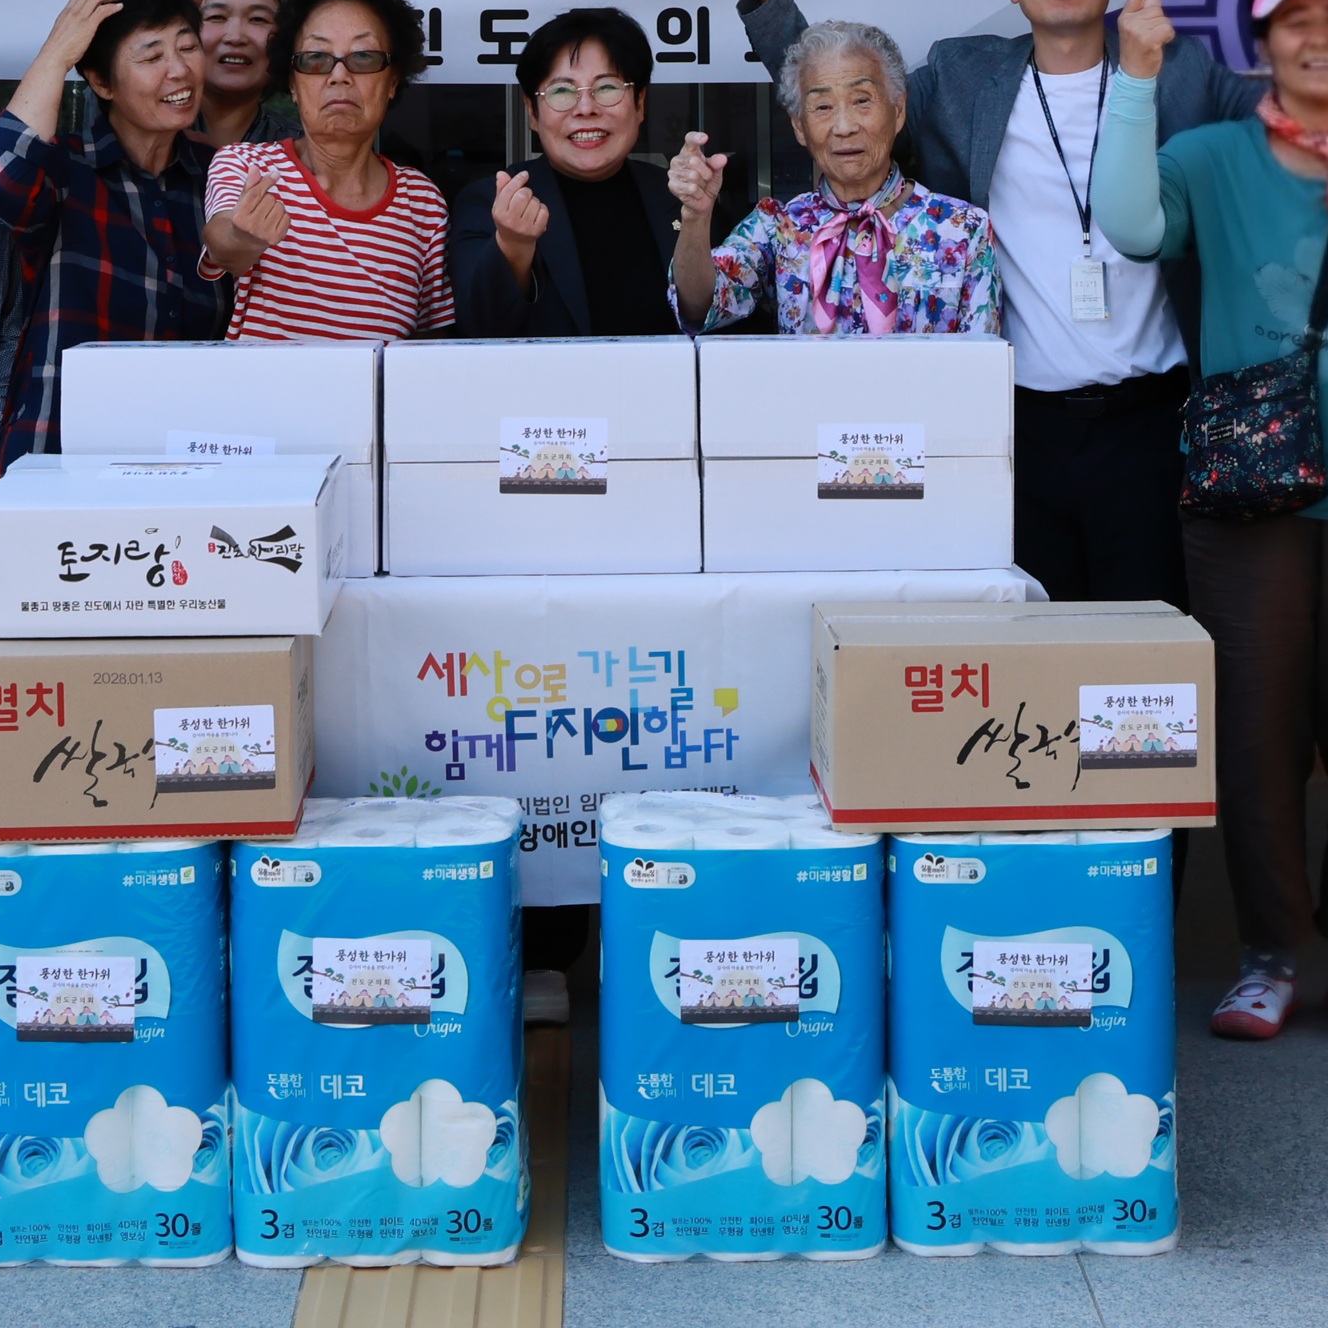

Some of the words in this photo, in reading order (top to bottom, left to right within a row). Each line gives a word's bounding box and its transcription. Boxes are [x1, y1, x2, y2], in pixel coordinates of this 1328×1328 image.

[522, 427, 553, 439] 풍성한
[556, 427, 586, 439] 한가위
[839, 433, 870, 444] 풍성한
[873, 433, 903, 445] 한가위
[187, 441, 219, 454] 풍성한
[222, 445, 253, 455] 한가위
[57, 539, 171, 588] 토지랑
[21, 601, 49, 613] 물좋고
[52, 600, 81, 612] 땅좋은
[84, 600, 122, 612] 진도에서
[125, 599, 144, 611] 자란
[147, 599, 176, 610] 특별한
[179, 598, 226, 610] 우리농산물
[93, 672, 163, 685] 2028.01.13
[416, 650, 567, 723] 세상으로
[905, 662, 990, 713] 멸치
[1104, 695, 1137, 708] 풍성한
[1141, 695, 1174, 707] 한가위
[178, 717, 213, 731] 풍성한
[217, 717, 250, 729] 한가위
[422, 867, 478, 881] #미래생활
[796, 869, 851, 882] #미래생활
[1087, 863, 1142, 877] #미래생활
[122, 872, 178, 887] #미래생활
[336, 949, 369, 962] 풍성한
[373, 950, 407, 963] 한가위
[704, 950, 738, 963] 풍성한
[742, 950, 775, 963] 한가위
[996, 953, 1032, 966] 풍성한
[1035, 954, 1068, 967] 한가위
[39, 967, 74, 980] 풍성한
[77, 968, 111, 981] 한가위
[121, 1022, 165, 1043] rigin
[266, 1073, 303, 1088] 도톰함
[636, 1073, 674, 1088] 도톰함
[929, 1066, 967, 1081] 도톰함
[984, 1067, 1031, 1093] 데코
[320, 1074, 367, 1100] 데코
[691, 1073, 738, 1099] 데코
[944, 1080, 970, 1091] 레시피
[23, 1082, 70, 1108] 데코
[279, 1088, 306, 1099] 레시피
[650, 1088, 677, 1098] 레시피
[926, 1200, 962, 1230] 3겹
[1045, 1207, 1070, 1216] 화이트
[1112, 1199, 1158, 1223] 30롤
[155, 1213, 202, 1238] 30롤
[260, 1209, 295, 1240] 3겹
[379, 1217, 405, 1226] 화이트
[446, 1208, 494, 1234] 30롤
[629, 1208, 665, 1238] 3겹
[749, 1216, 774, 1225] 화이트
[817, 1206, 864, 1231] 30롤
[86, 1222, 112, 1232] 화이트
